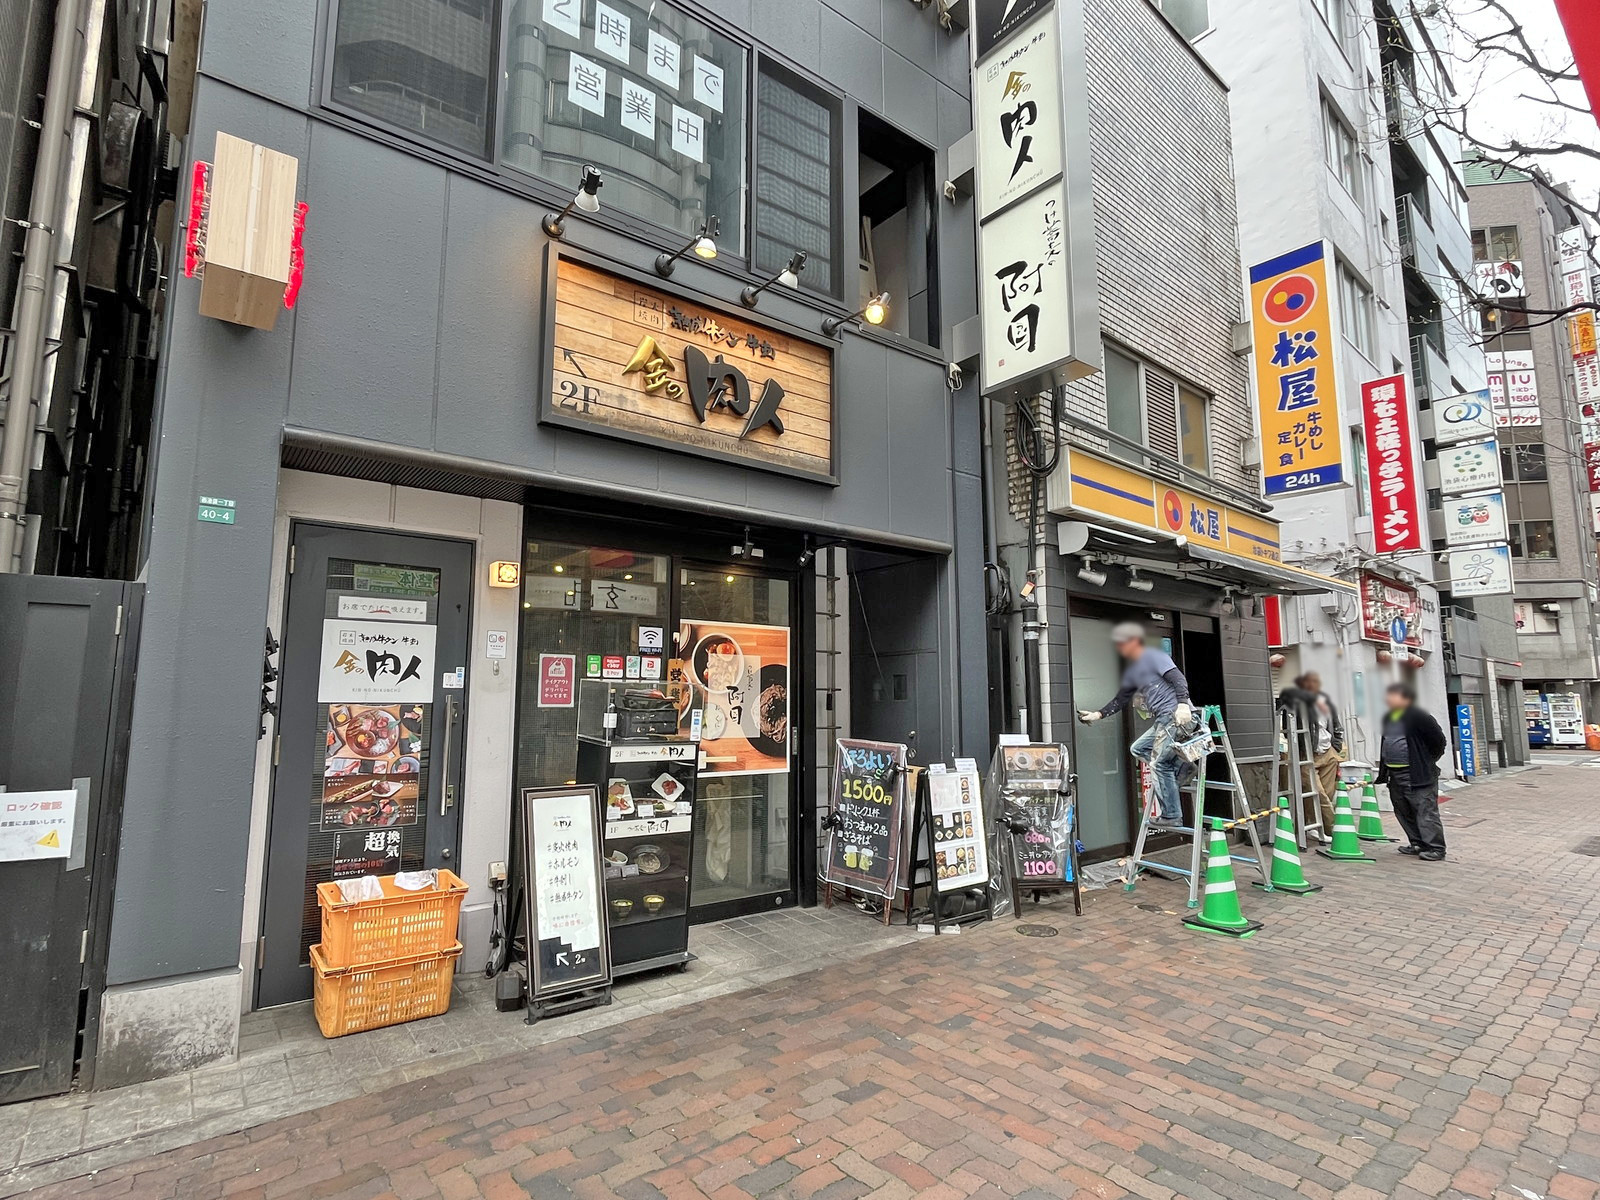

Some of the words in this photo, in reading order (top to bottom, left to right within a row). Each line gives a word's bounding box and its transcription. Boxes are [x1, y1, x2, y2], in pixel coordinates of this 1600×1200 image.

[574, 64, 699, 144] 営業中
[1270, 329, 1320, 413] 松屋
[560, 380, 600, 414] 2F
[1511, 394, 1537, 402] 1560
[1293, 422, 1307, 460] カレー
[1307, 411, 1323, 451] 牛めし
[1277, 431, 1294, 467] 定食
[1370, 382, 1410, 547] 環七土佐っ子ラーメン
[1285, 472, 1321, 489] 24h
[201, 509, 230, 521] 40-4
[1189, 503, 1220, 541] 松屋
[1460, 707, 1471, 736] くすり
[842, 778, 892, 805] 1500円
[843, 817, 888, 836] おつまみ2品
